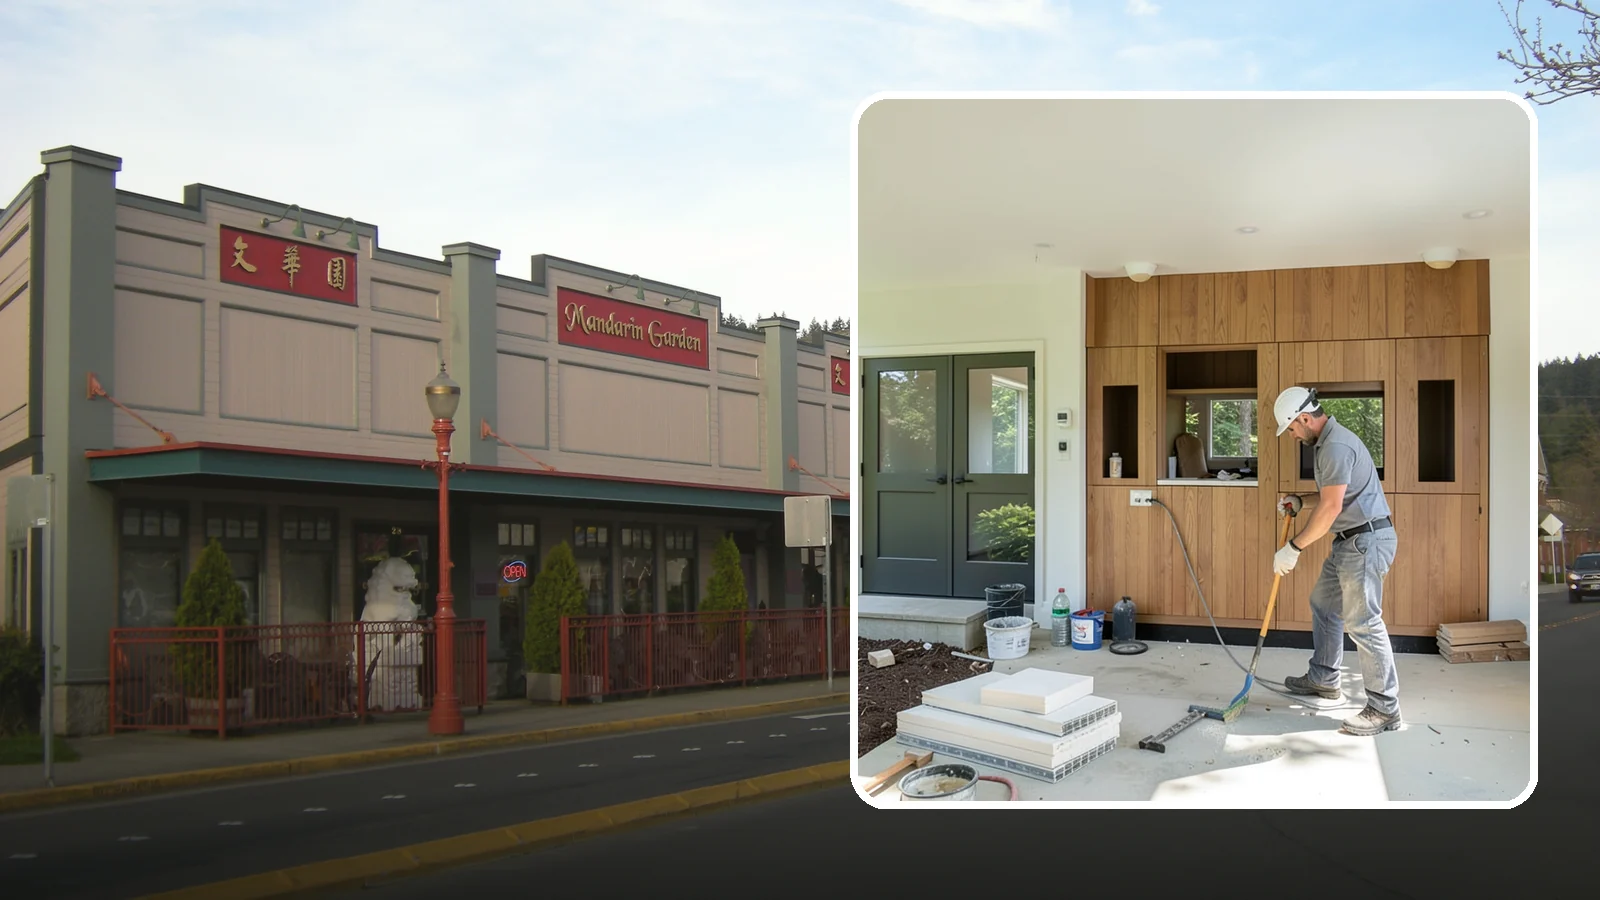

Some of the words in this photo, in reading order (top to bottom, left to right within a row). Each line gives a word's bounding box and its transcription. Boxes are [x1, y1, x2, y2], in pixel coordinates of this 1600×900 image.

[231, 235, 346, 291] 文華園
[564, 302, 644, 341] Mandarin
[648, 320, 702, 352] Garden
[503, 565, 527, 578] OPEN
